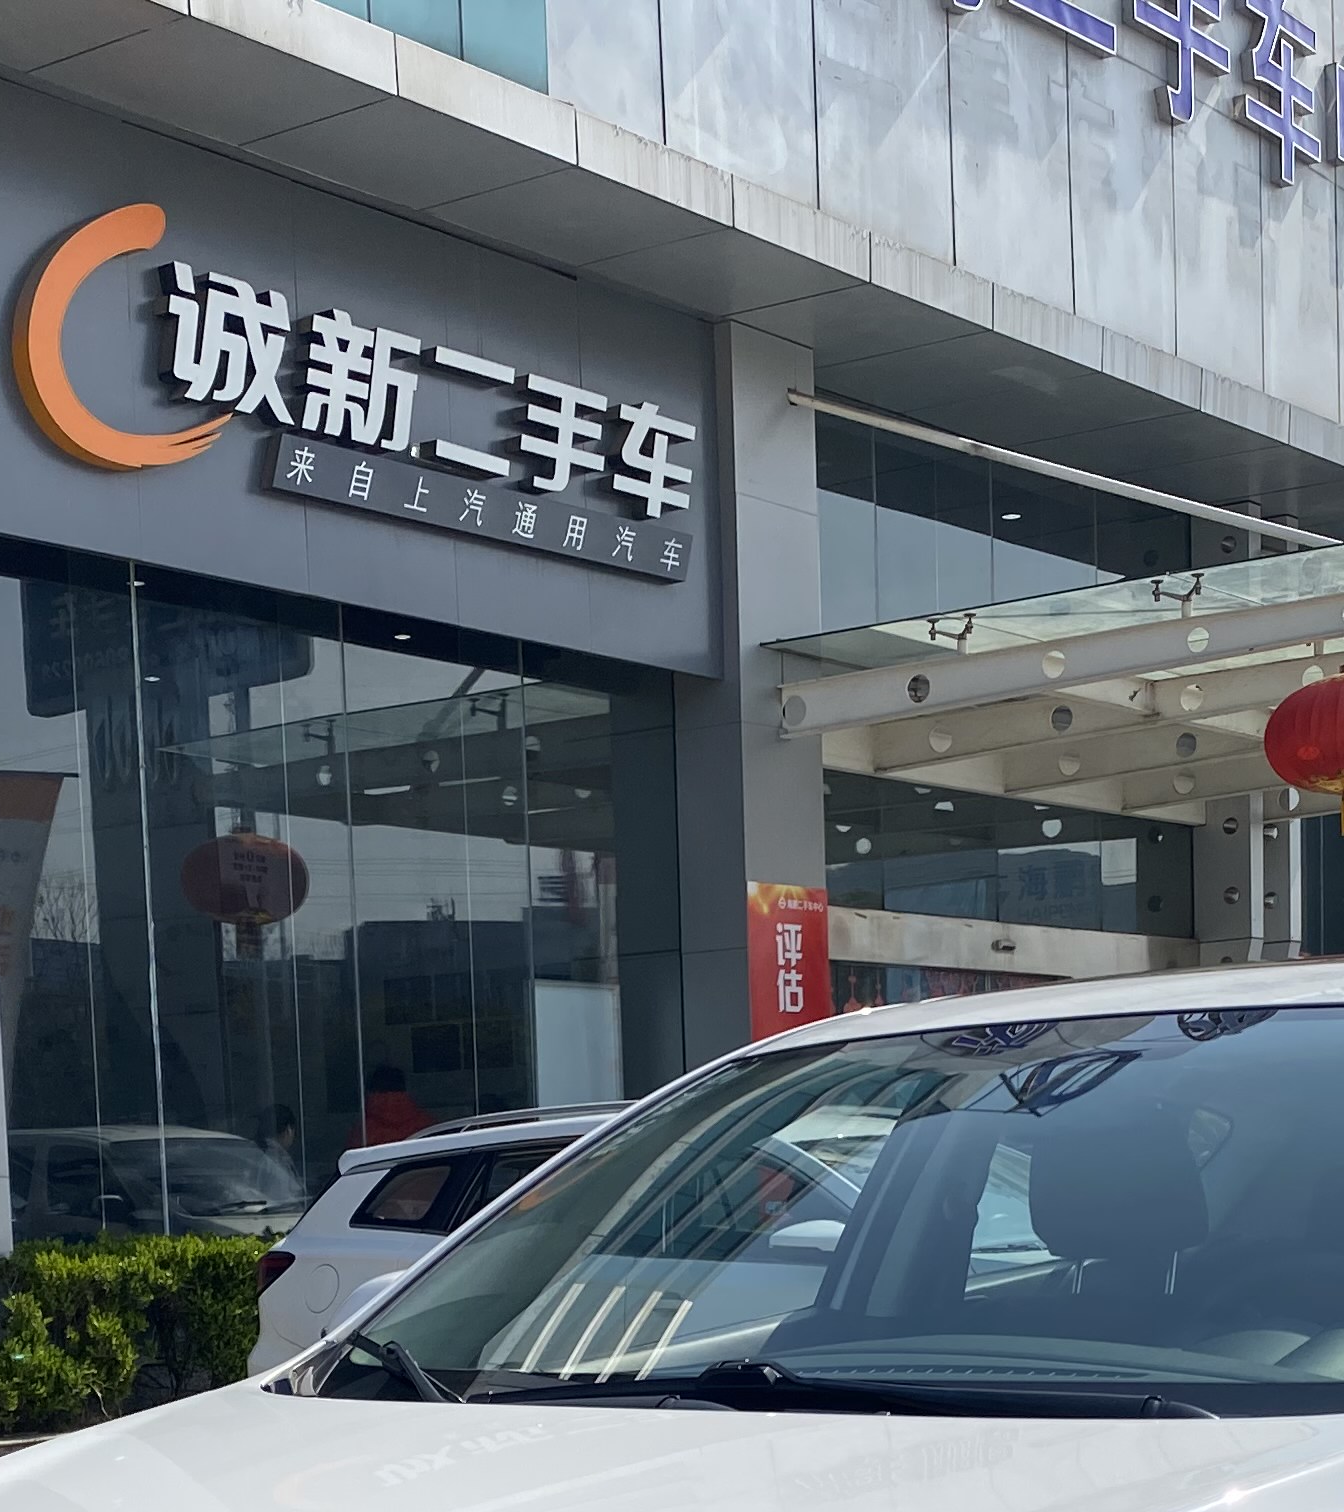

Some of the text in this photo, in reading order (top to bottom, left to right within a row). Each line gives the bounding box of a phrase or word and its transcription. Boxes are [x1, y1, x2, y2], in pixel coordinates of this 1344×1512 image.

[160, 260, 697, 519] 诚新二手车
[286, 446, 684, 573] 来自上汽通用汽车
[775, 922, 805, 1013] 评估
